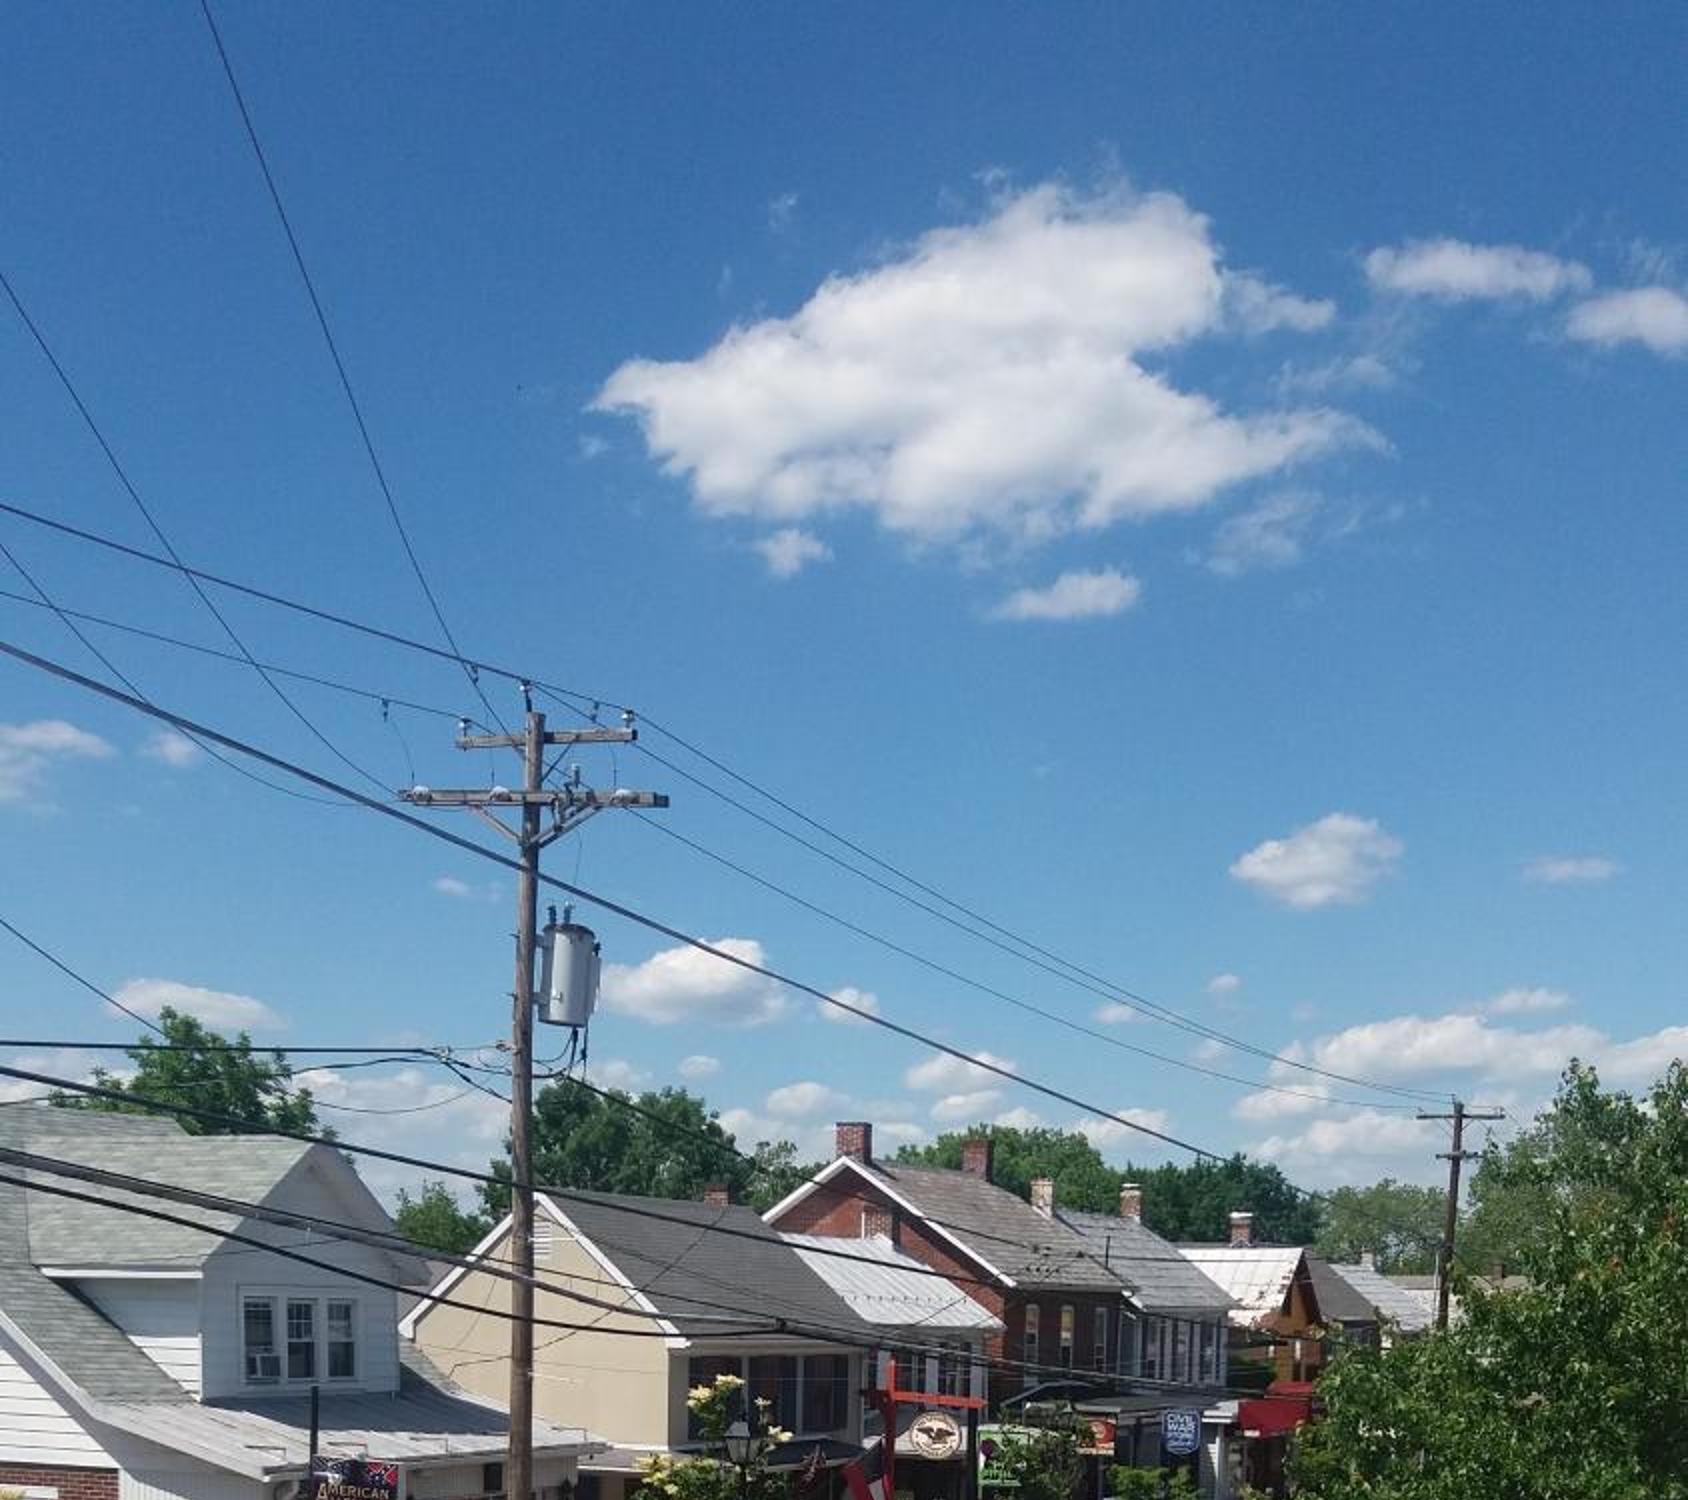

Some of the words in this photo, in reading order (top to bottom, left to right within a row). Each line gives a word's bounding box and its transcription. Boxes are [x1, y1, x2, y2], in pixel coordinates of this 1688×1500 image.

[1167, 1413, 1193, 1424] CIVIL
[1168, 1422, 1195, 1433] WAR
[317, 1483, 390, 1500] AMERICAN
